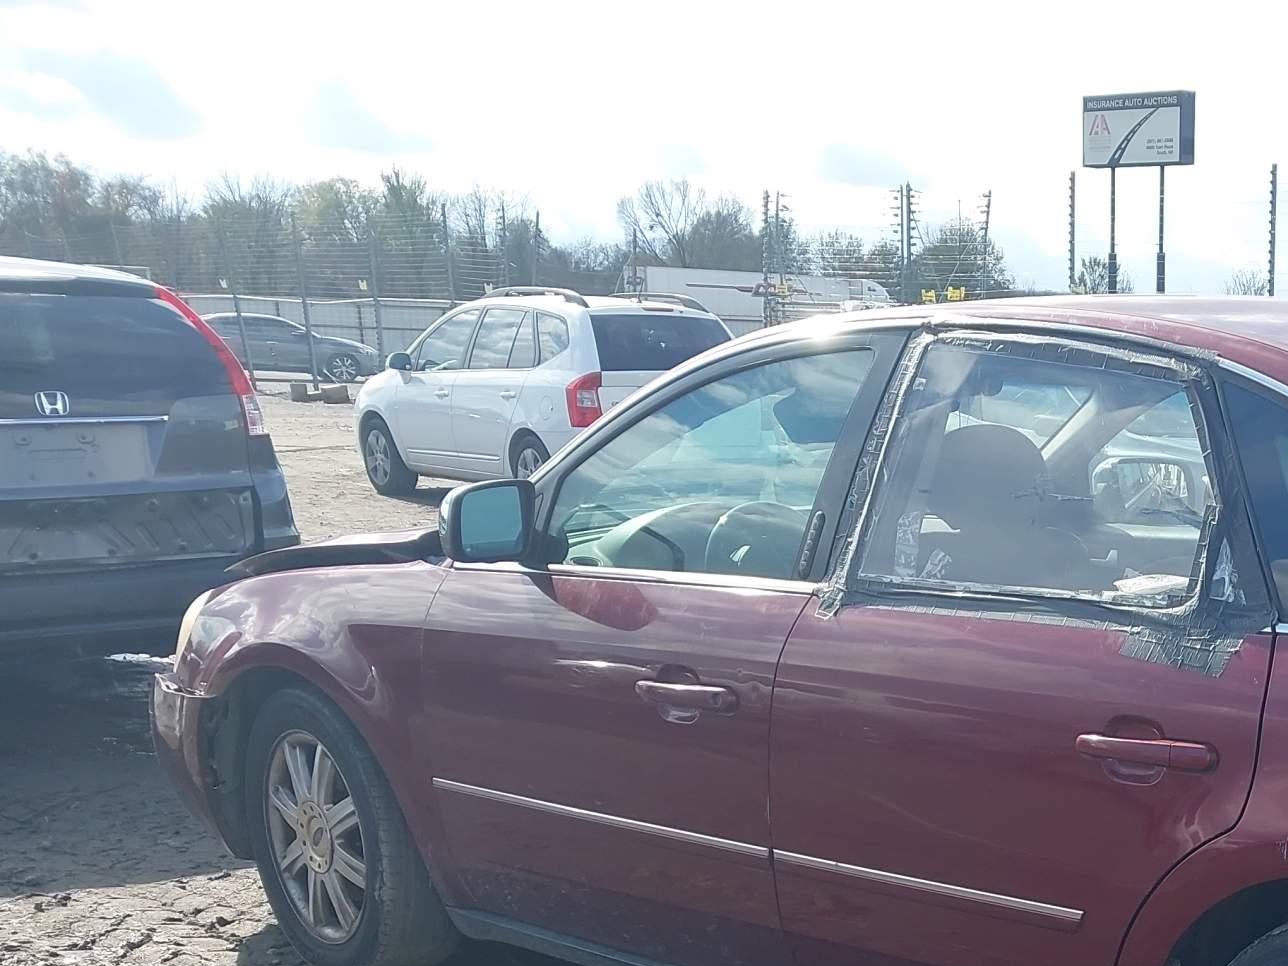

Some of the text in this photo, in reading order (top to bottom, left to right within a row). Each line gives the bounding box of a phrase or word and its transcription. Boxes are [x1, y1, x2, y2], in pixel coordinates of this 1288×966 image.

[1087, 96, 1178, 109] INSURANCE AUTO AUCTIONS
